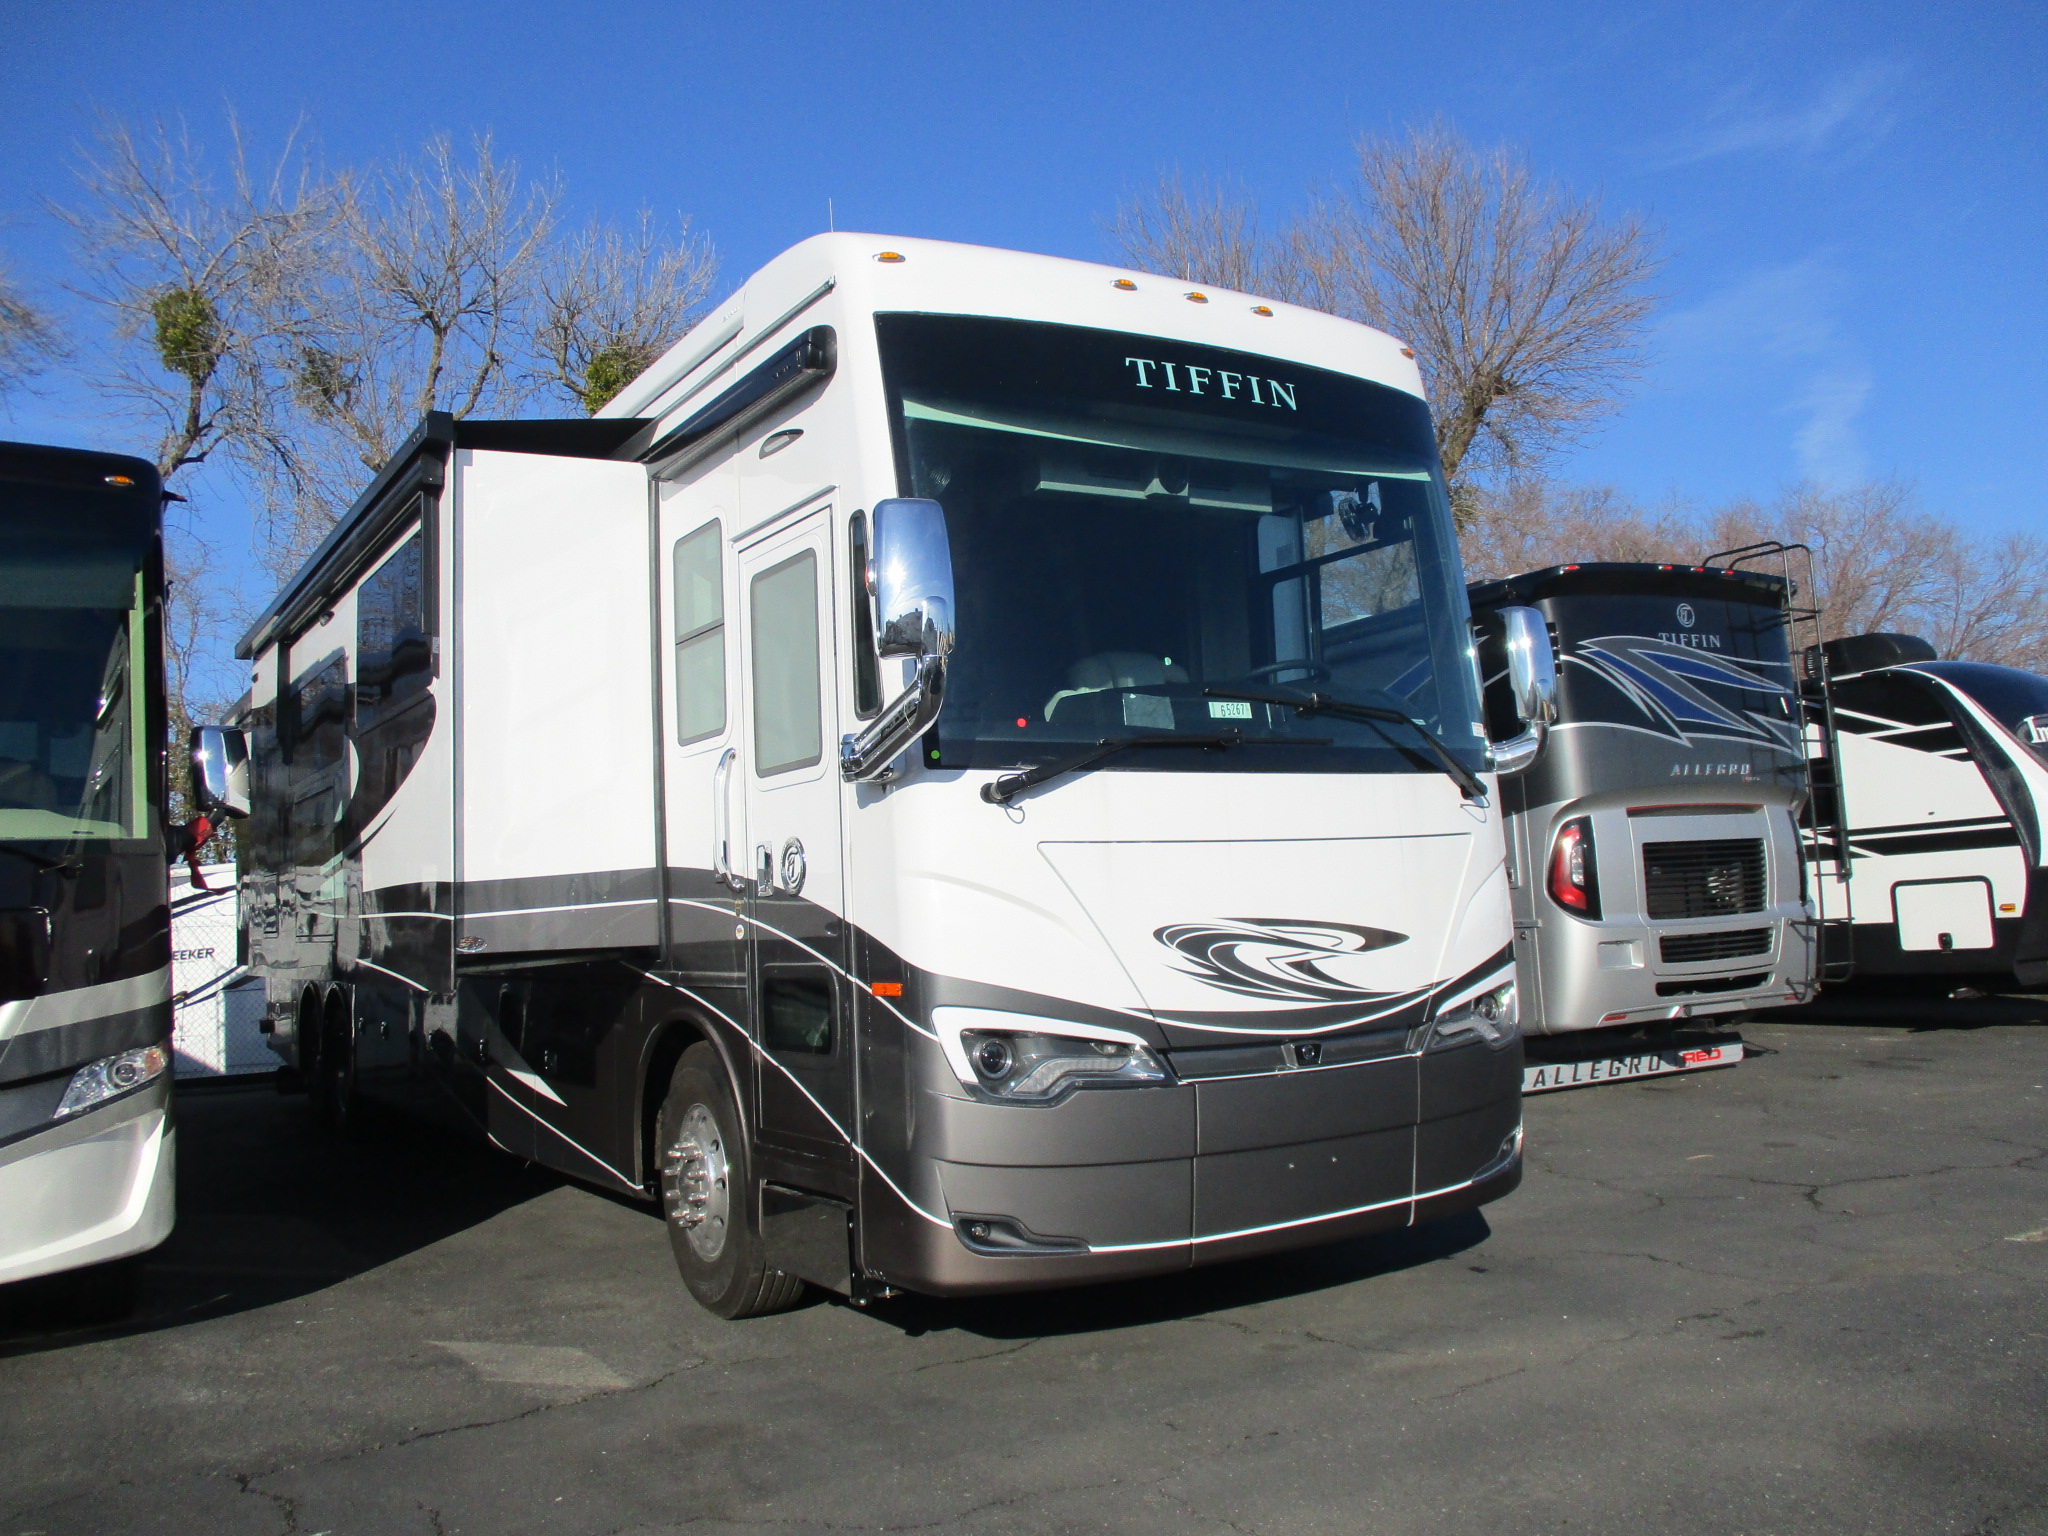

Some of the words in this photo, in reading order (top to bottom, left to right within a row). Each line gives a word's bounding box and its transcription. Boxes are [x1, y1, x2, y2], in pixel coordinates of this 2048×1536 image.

[1125, 356, 1297, 411] TIFFIN
[1658, 632, 1721, 648] TIFFIN
[1220, 703, 1245, 717] 65267
[1532, 1055, 1661, 1088] ALLEGRO
[1683, 1048, 1722, 1063] RED
